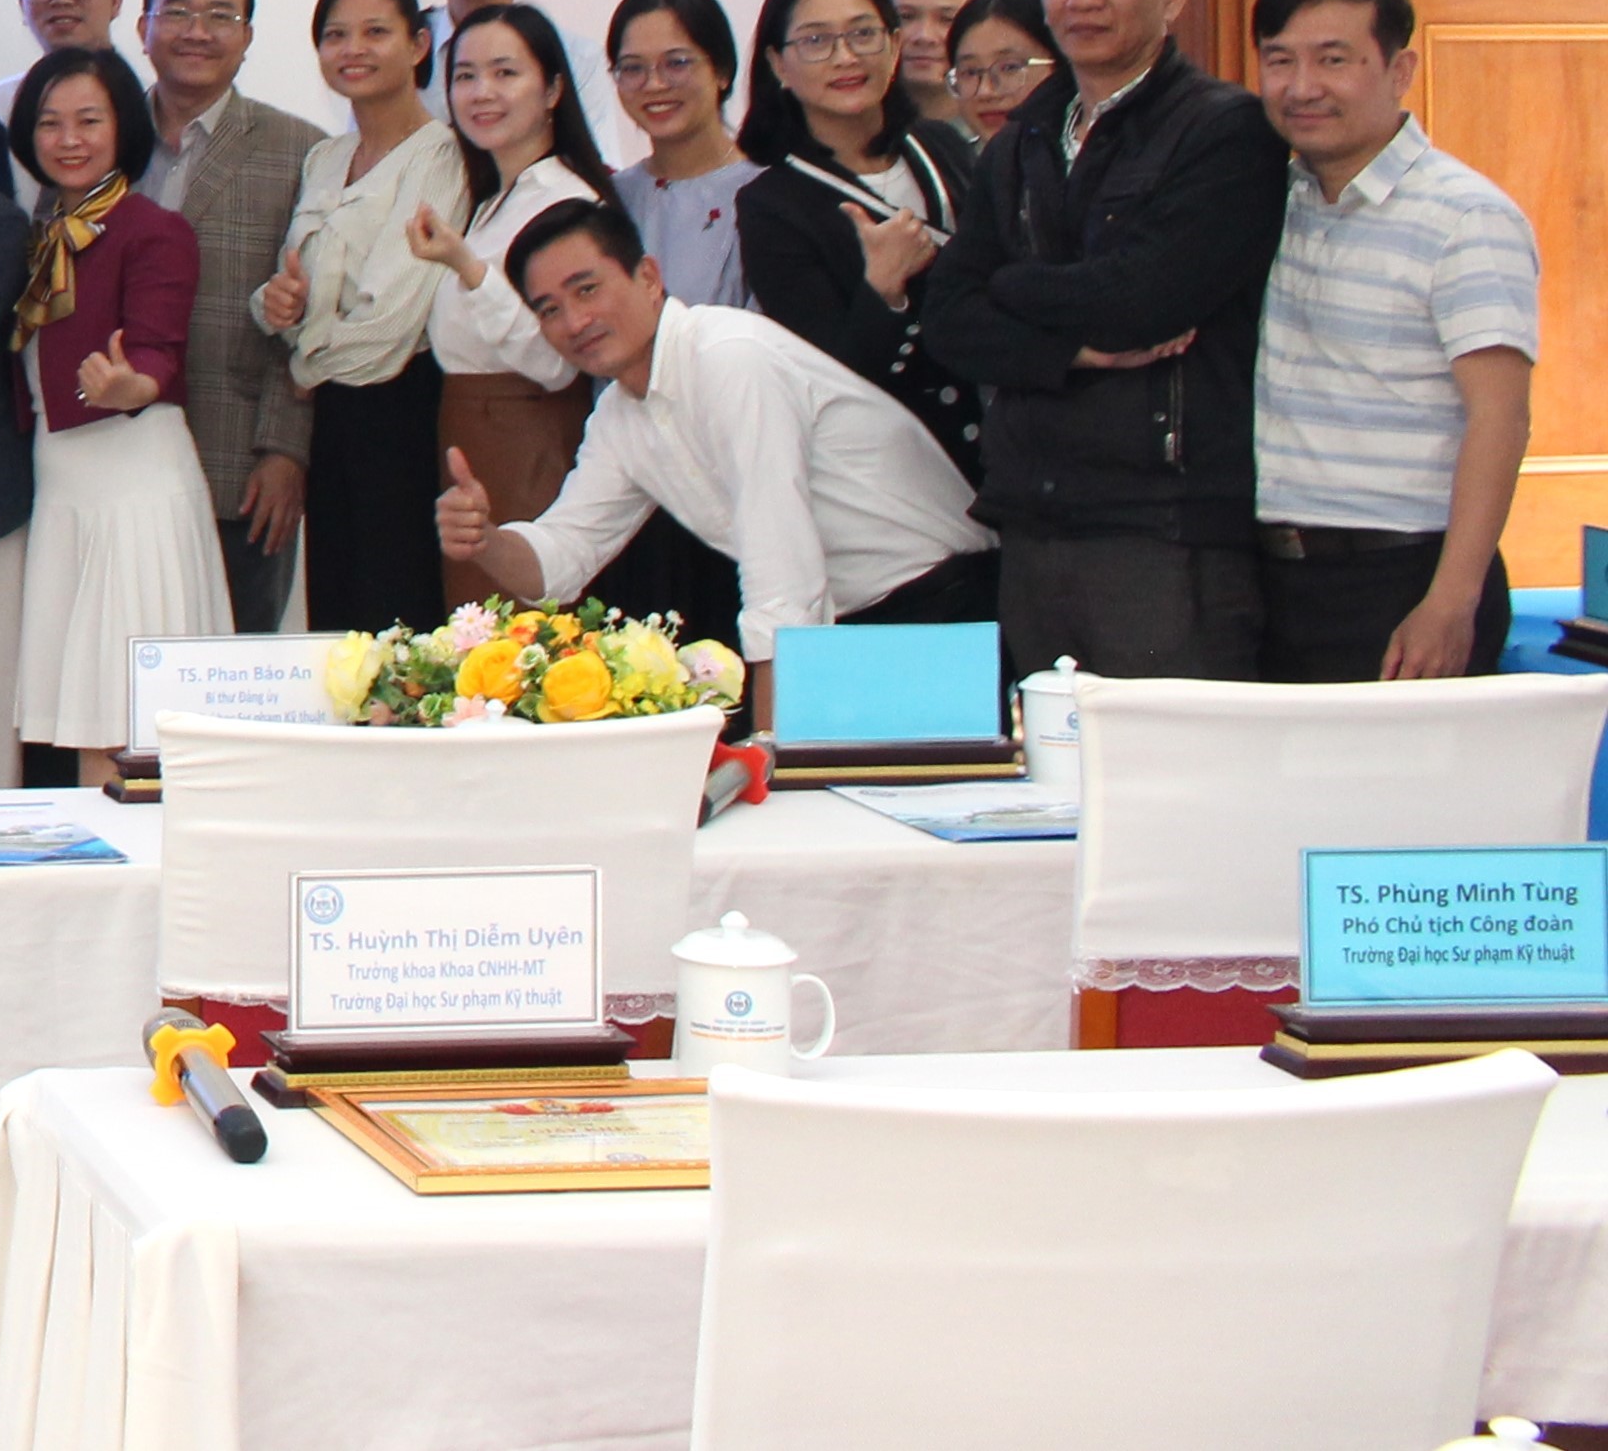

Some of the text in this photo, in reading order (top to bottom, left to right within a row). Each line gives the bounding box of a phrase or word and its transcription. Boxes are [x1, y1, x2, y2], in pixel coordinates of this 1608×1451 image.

[178, 667, 202, 682] TS.
[208, 666, 248, 682] Phan
[290, 665, 312, 679] An
[1337, 882, 1578, 907] TS. Phùng Minh Tùng
[1342, 914, 1574, 936] Phó Chủ tịch Công đoàn
[310, 923, 583, 953] TS. Huỳnh Thị Diễm Uyên
[1343, 943, 1575, 967] Trường Đại học Sư phạm Kỹ thuật
[402, 961, 435, 979] khoa
[440, 959, 474, 979] Khoa
[478, 959, 546, 978] CNHH-MT
[330, 988, 562, 1013] Trường Đại học Sư phạm Kỹ thuật
